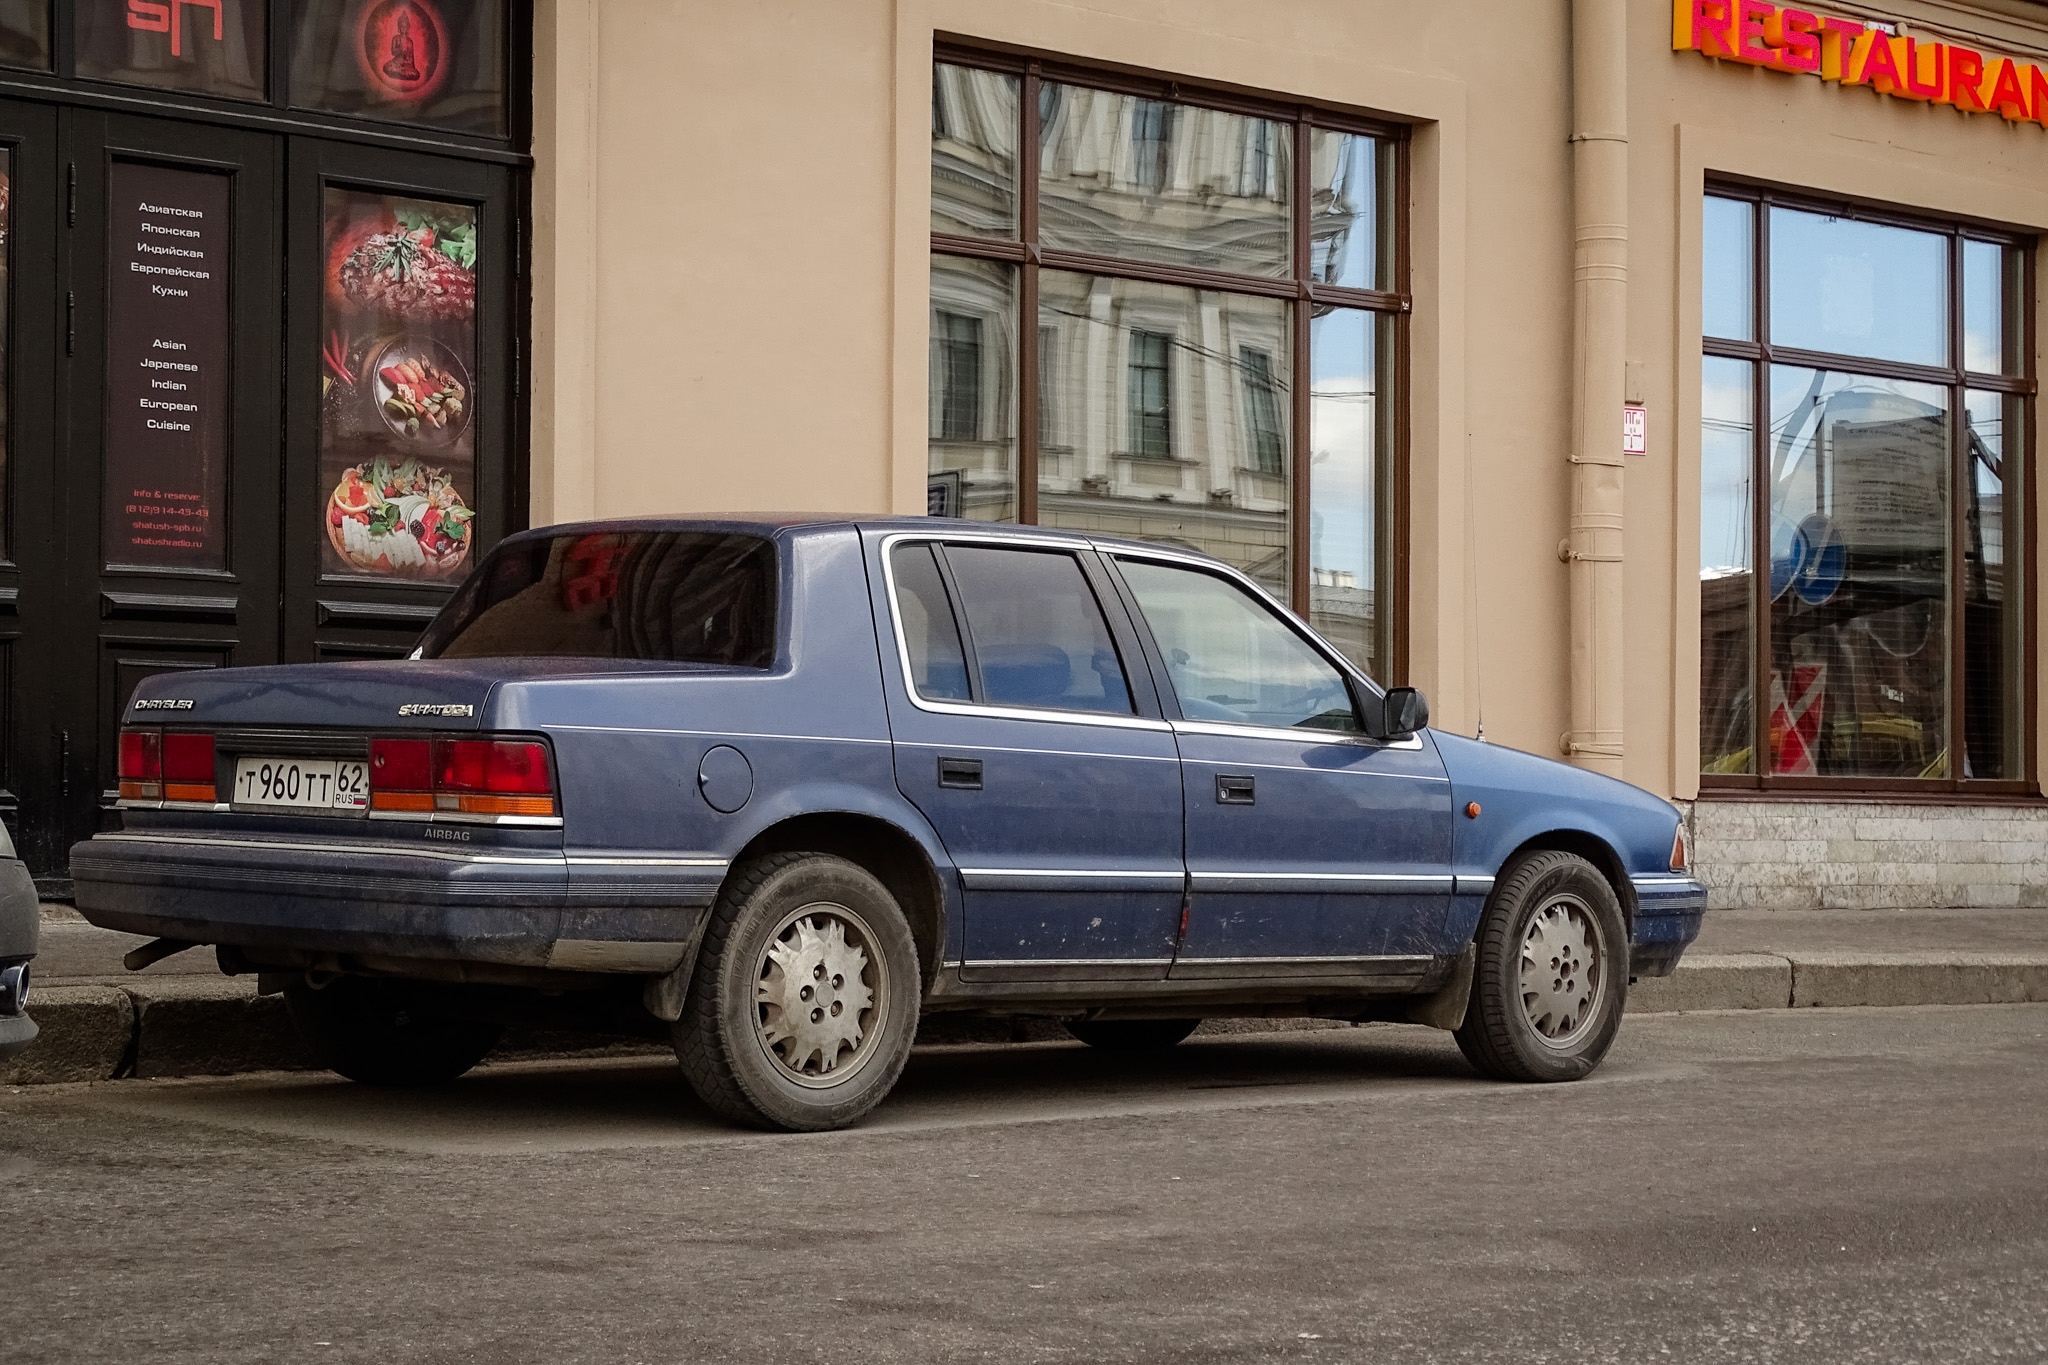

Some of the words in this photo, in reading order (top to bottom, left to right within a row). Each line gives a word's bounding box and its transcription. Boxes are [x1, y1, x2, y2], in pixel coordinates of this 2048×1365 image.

[138, 202, 203, 219] Азиатская
[141, 223, 201, 239] Японская
[137, 242, 204, 259] Индийская
[130, 262, 210, 280] Европейская
[152, 285, 189, 297] Кухни
[152, 339, 187, 351] Asian
[140, 358, 198, 372] Japanese
[151, 379, 187, 391] Indian
[139, 398, 198, 412] European
[146, 419, 191, 431] Cuisine
[153, 491, 161, 499] &
[134, 699, 194, 710] CHRYSLER
[338, 764, 363, 793] 62
[335, 793, 353, 804] RUS
[424, 828, 470, 841] AIRBAG
